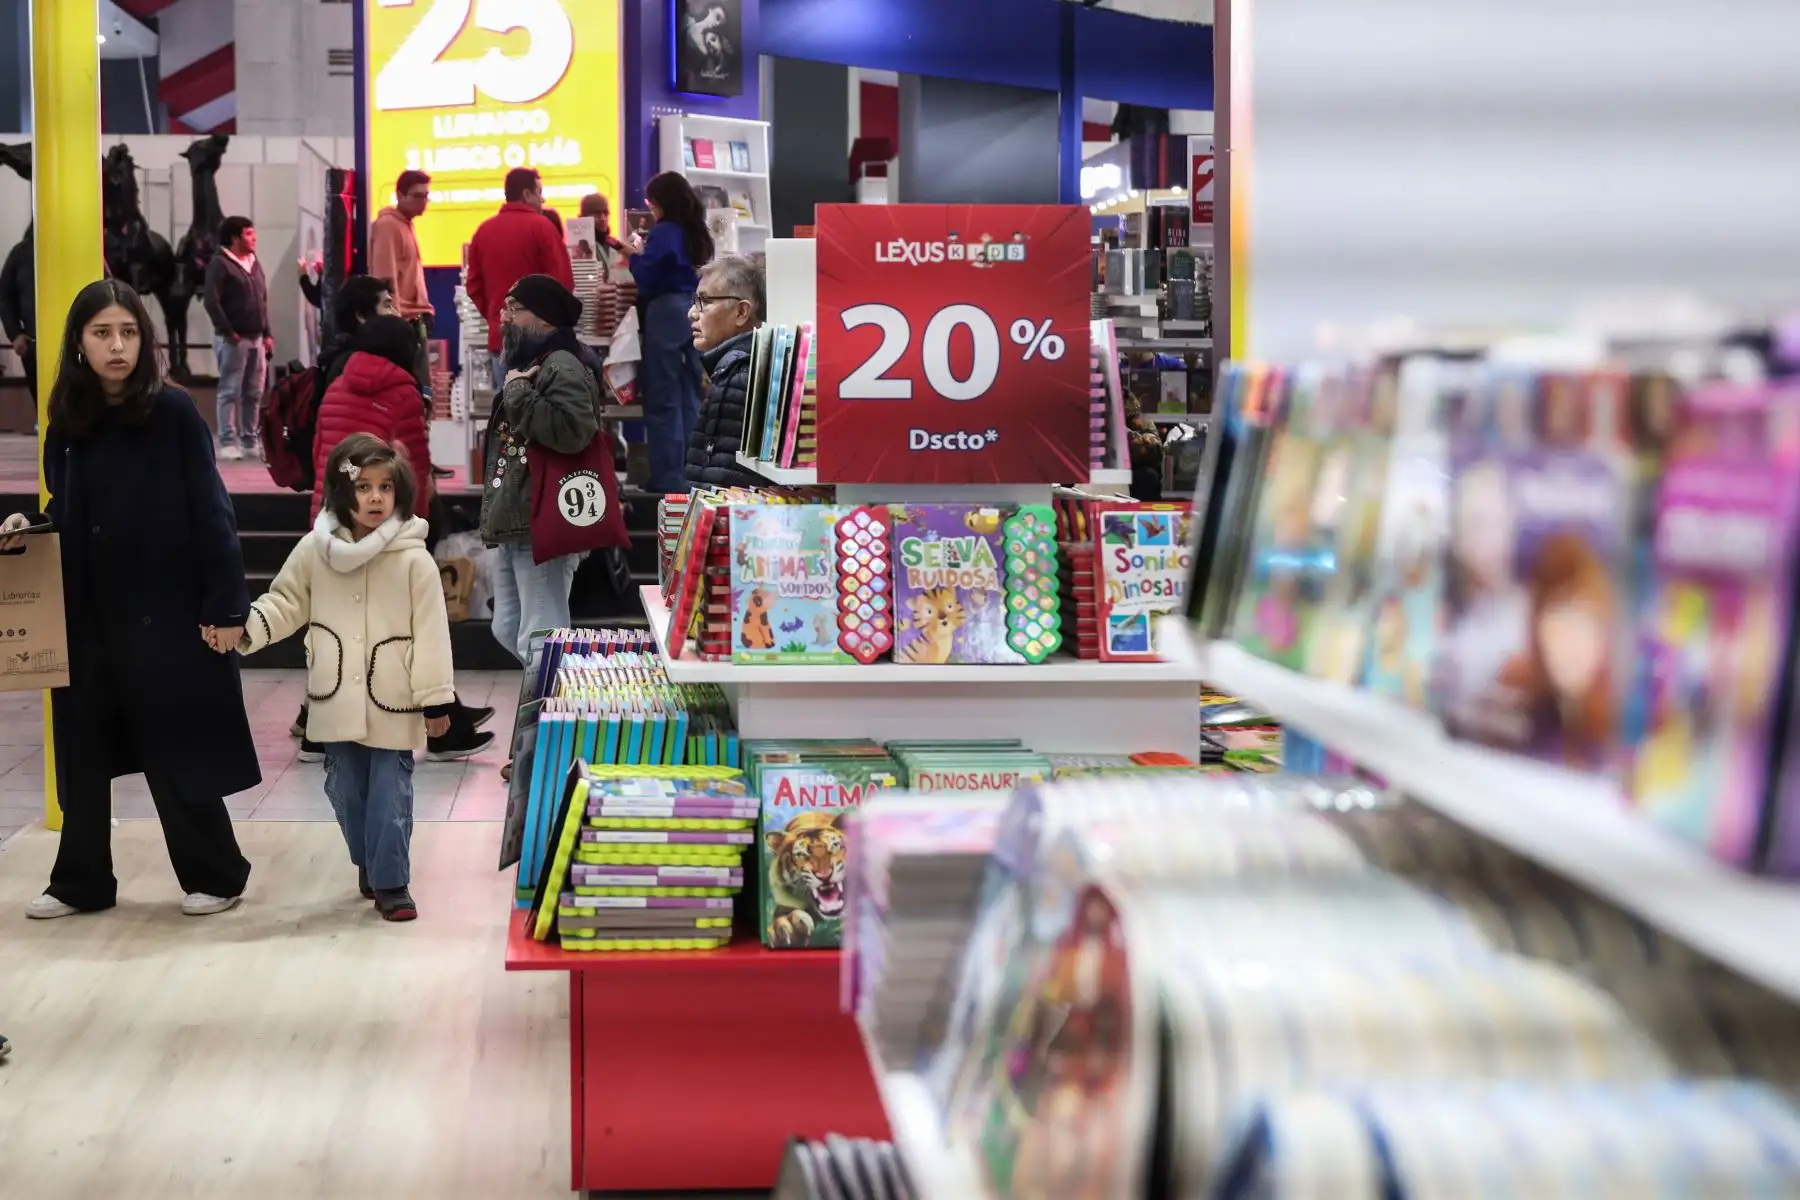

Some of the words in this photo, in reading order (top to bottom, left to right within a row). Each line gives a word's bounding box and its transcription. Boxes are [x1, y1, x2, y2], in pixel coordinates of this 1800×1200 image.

[875, 237, 945, 266] LEXUS
[901, 537, 997, 568] SELVA
[907, 567, 997, 590] RUIDOSA
